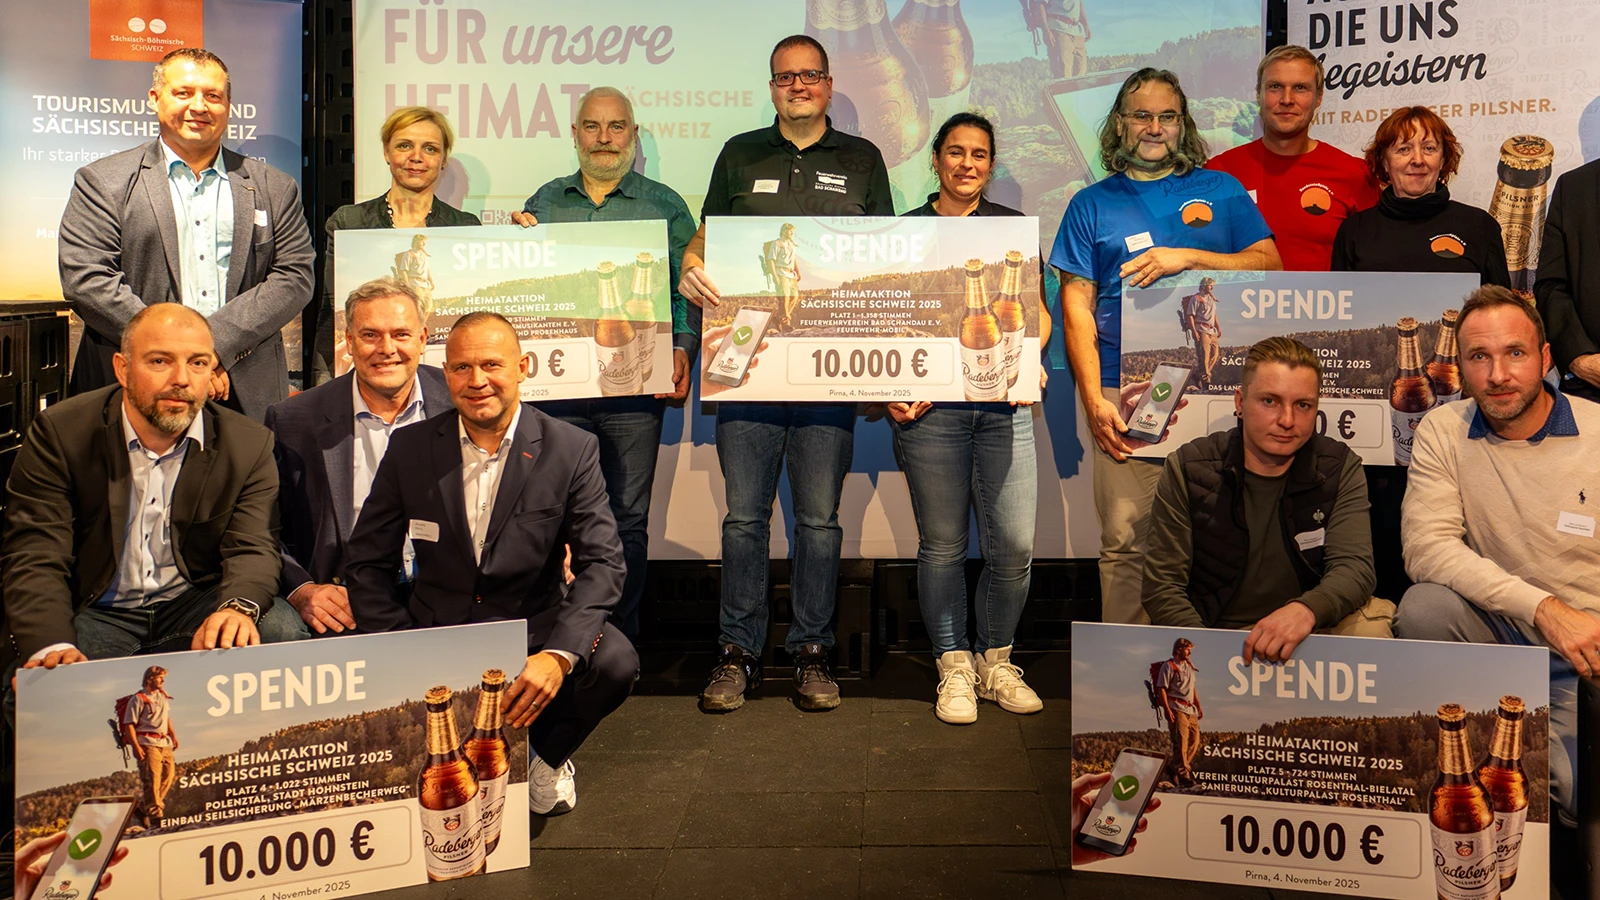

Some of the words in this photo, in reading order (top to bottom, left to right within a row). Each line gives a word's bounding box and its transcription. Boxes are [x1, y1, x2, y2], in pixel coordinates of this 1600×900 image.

[384, 0, 487, 65] FÜR
[501, 24, 675, 66] unsere
[1309, 8, 1366, 50] DIE
[1380, 0, 1459, 43] UNS
[110, 34, 184, 45] Sächsisch-Böhmische
[131, 44, 164, 52] SCHWEIZ
[625, 85, 753, 107] ÄCHSISCHE
[1309, 112, 1335, 126] MIT
[1469, 98, 1557, 117] PILSNER.
[23, 147, 44, 161] Ihr
[1501, 191, 1540, 203] PILSNER
[452, 239, 558, 271] SPENDE
[819, 233, 924, 262] SPENDE
[466, 294, 546, 305] HEIMATAKTION
[800, 298, 866, 309] SÄCHSISCHE
[869, 300, 916, 309] SCHWEIZ
[918, 300, 942, 309] 2025
[831, 290, 911, 298] HEIMATAKTION
[1240, 288, 1354, 321] SPENDE
[504, 303, 551, 313] SCHWEIZ
[553, 302, 577, 311] 2025
[548, 349, 565, 377] €
[812, 349, 902, 378] 10.000
[911, 348, 928, 378] €
[1346, 360, 1371, 369] 2025
[531, 389, 549, 397] 2025
[829, 389, 848, 397] Pirna,
[1319, 387, 1350, 395] HSISCHE
[1337, 410, 1356, 440] €
[206, 660, 366, 717] SPENDE
[1227, 655, 1378, 704] SPENDE
[227, 741, 348, 768] HEIMATAKTION
[1246, 734, 1359, 753] HEIMATAKTION
[179, 764, 282, 789] SÄCHSISCHE
[286, 754, 356, 774] SCHWEIZ
[359, 750, 393, 765] 2025
[1203, 743, 1295, 763] SÄCHSISCHE
[1299, 752, 1366, 768] SCHWEIZ
[1370, 757, 1404, 771] 2025
[225, 785, 257, 797] PLATZ
[260, 783, 266, 792] 4
[275, 779, 300, 790] 1.022
[302, 772, 351, 786] STIMMEN
[1192, 771, 1228, 781] VEREIN
[1231, 774, 1304, 788] KULTURPALAST
[1306, 780, 1416, 796] ROSENTHAL-BIELATAL
[1247, 765, 1276, 775] PLATZ
[1292, 768, 1309, 777] 724
[1310, 770, 1357, 781] STIMMEN
[205, 795, 271, 811] POLENZTAL,
[273, 789, 305, 801] STADT
[307, 780, 369, 796] HOHNSTEIN
[1201, 782, 1259, 794] SANIERUNG
[160, 814, 202, 828] EINBAU
[205, 801, 291, 821] SEILSICHERUNG
[1220, 814, 1346, 862] 10.000
[1359, 824, 1385, 866] €
[199, 827, 336, 886] 10.000
[350, 820, 375, 861] €
[272, 887, 322, 900] November
[324, 880, 351, 893] 2025
[1245, 870, 1271, 882] Pirna,
[1273, 873, 1283, 882] 4.
[1285, 874, 1332, 887] November
[1334, 878, 1360, 889] 2025
